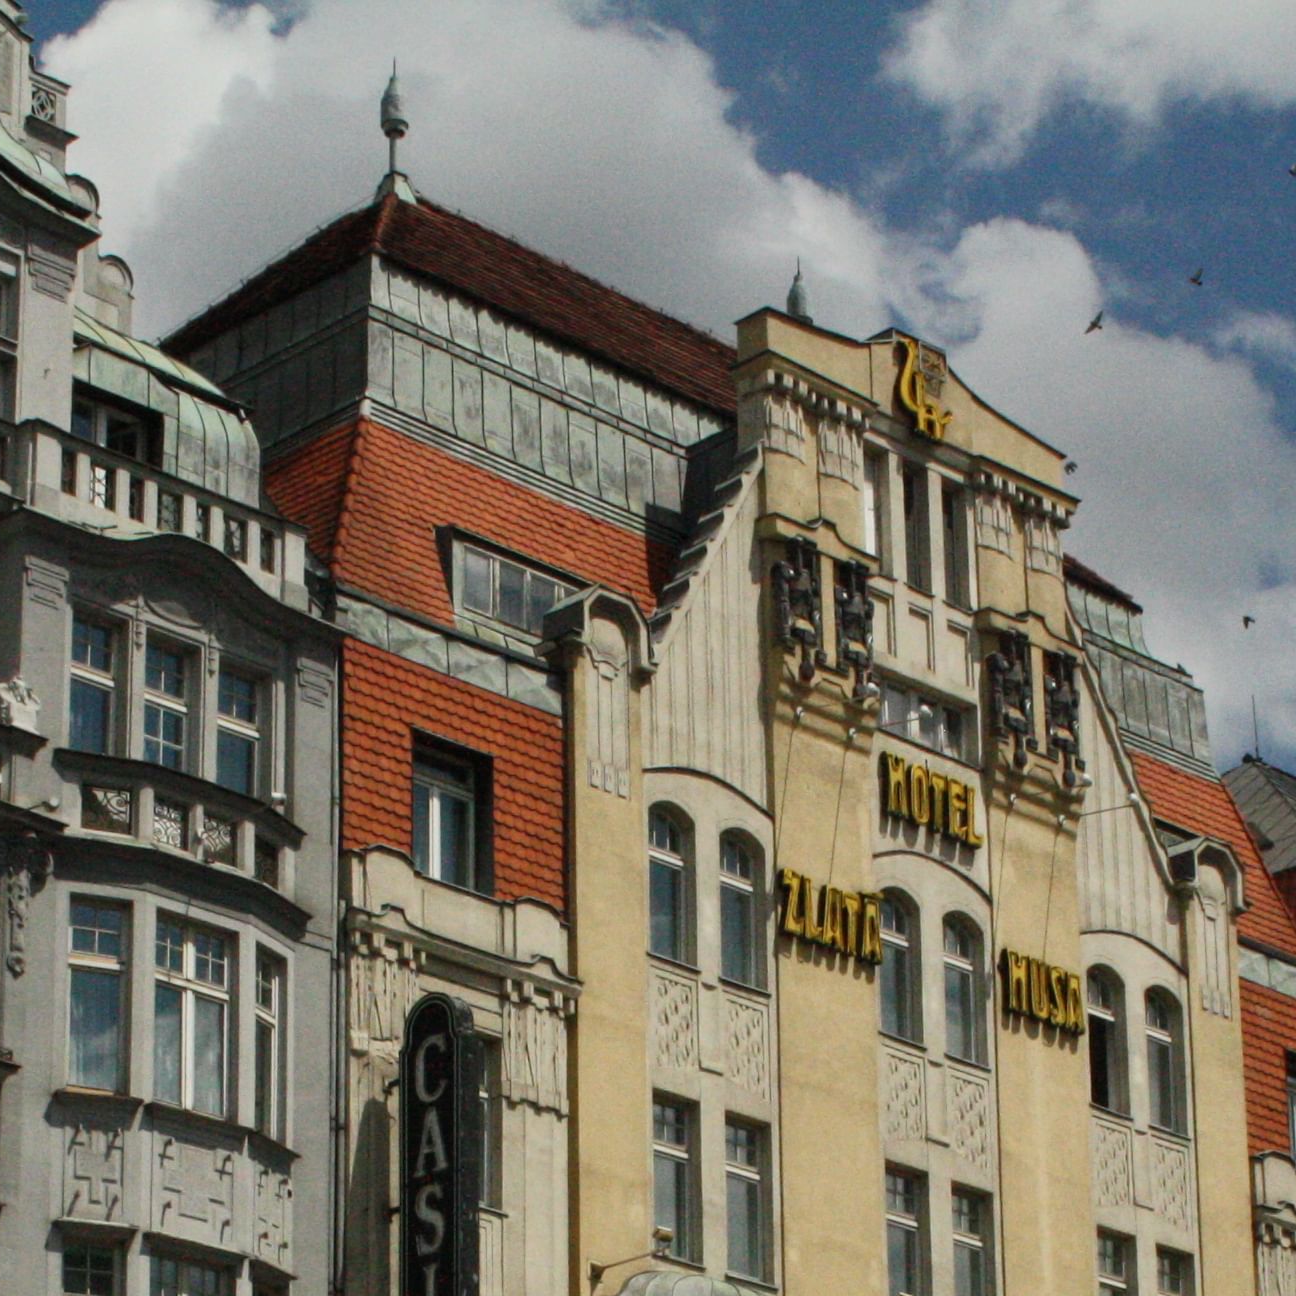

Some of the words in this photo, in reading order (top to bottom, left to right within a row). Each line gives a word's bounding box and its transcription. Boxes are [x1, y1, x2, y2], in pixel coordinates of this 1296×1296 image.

[882, 752, 983, 848] HOTEL
[779, 868, 884, 965] ZLATÁ
[1004, 949, 1085, 1035] HUSA
